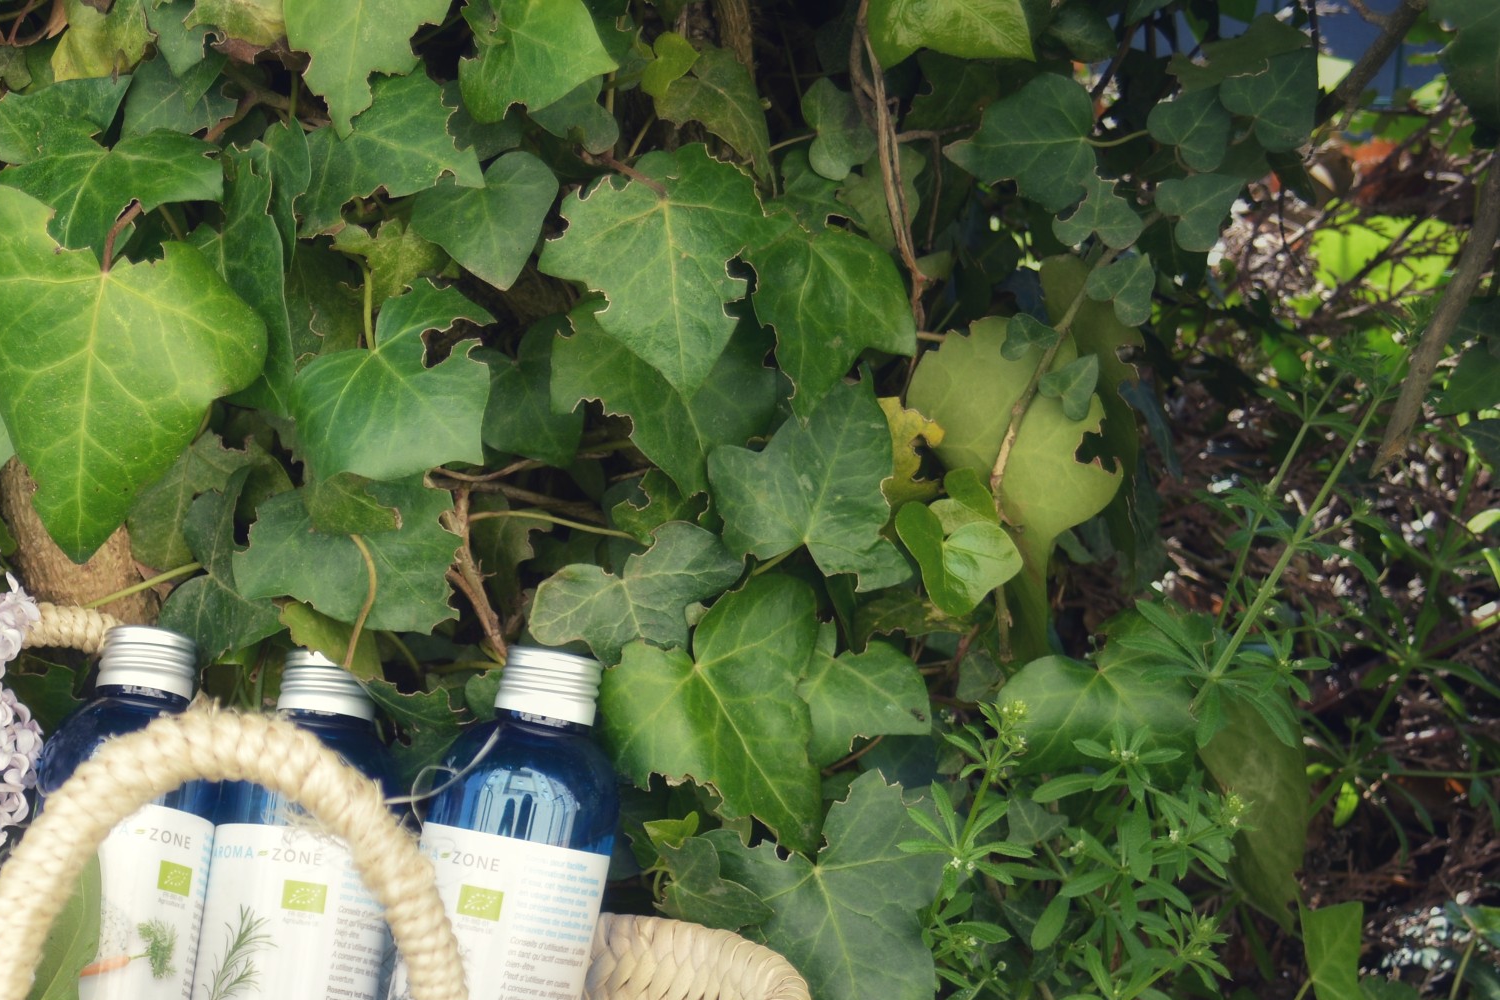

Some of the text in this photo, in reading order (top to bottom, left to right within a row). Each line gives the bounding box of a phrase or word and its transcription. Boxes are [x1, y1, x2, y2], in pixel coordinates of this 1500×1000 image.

[149, 827, 191, 849] ZONE
[272, 848, 323, 866] ZONE
[452, 851, 501, 872] ZONE
[509, 936, 538, 949] Conseils
[503, 970, 519, 981] Peut
